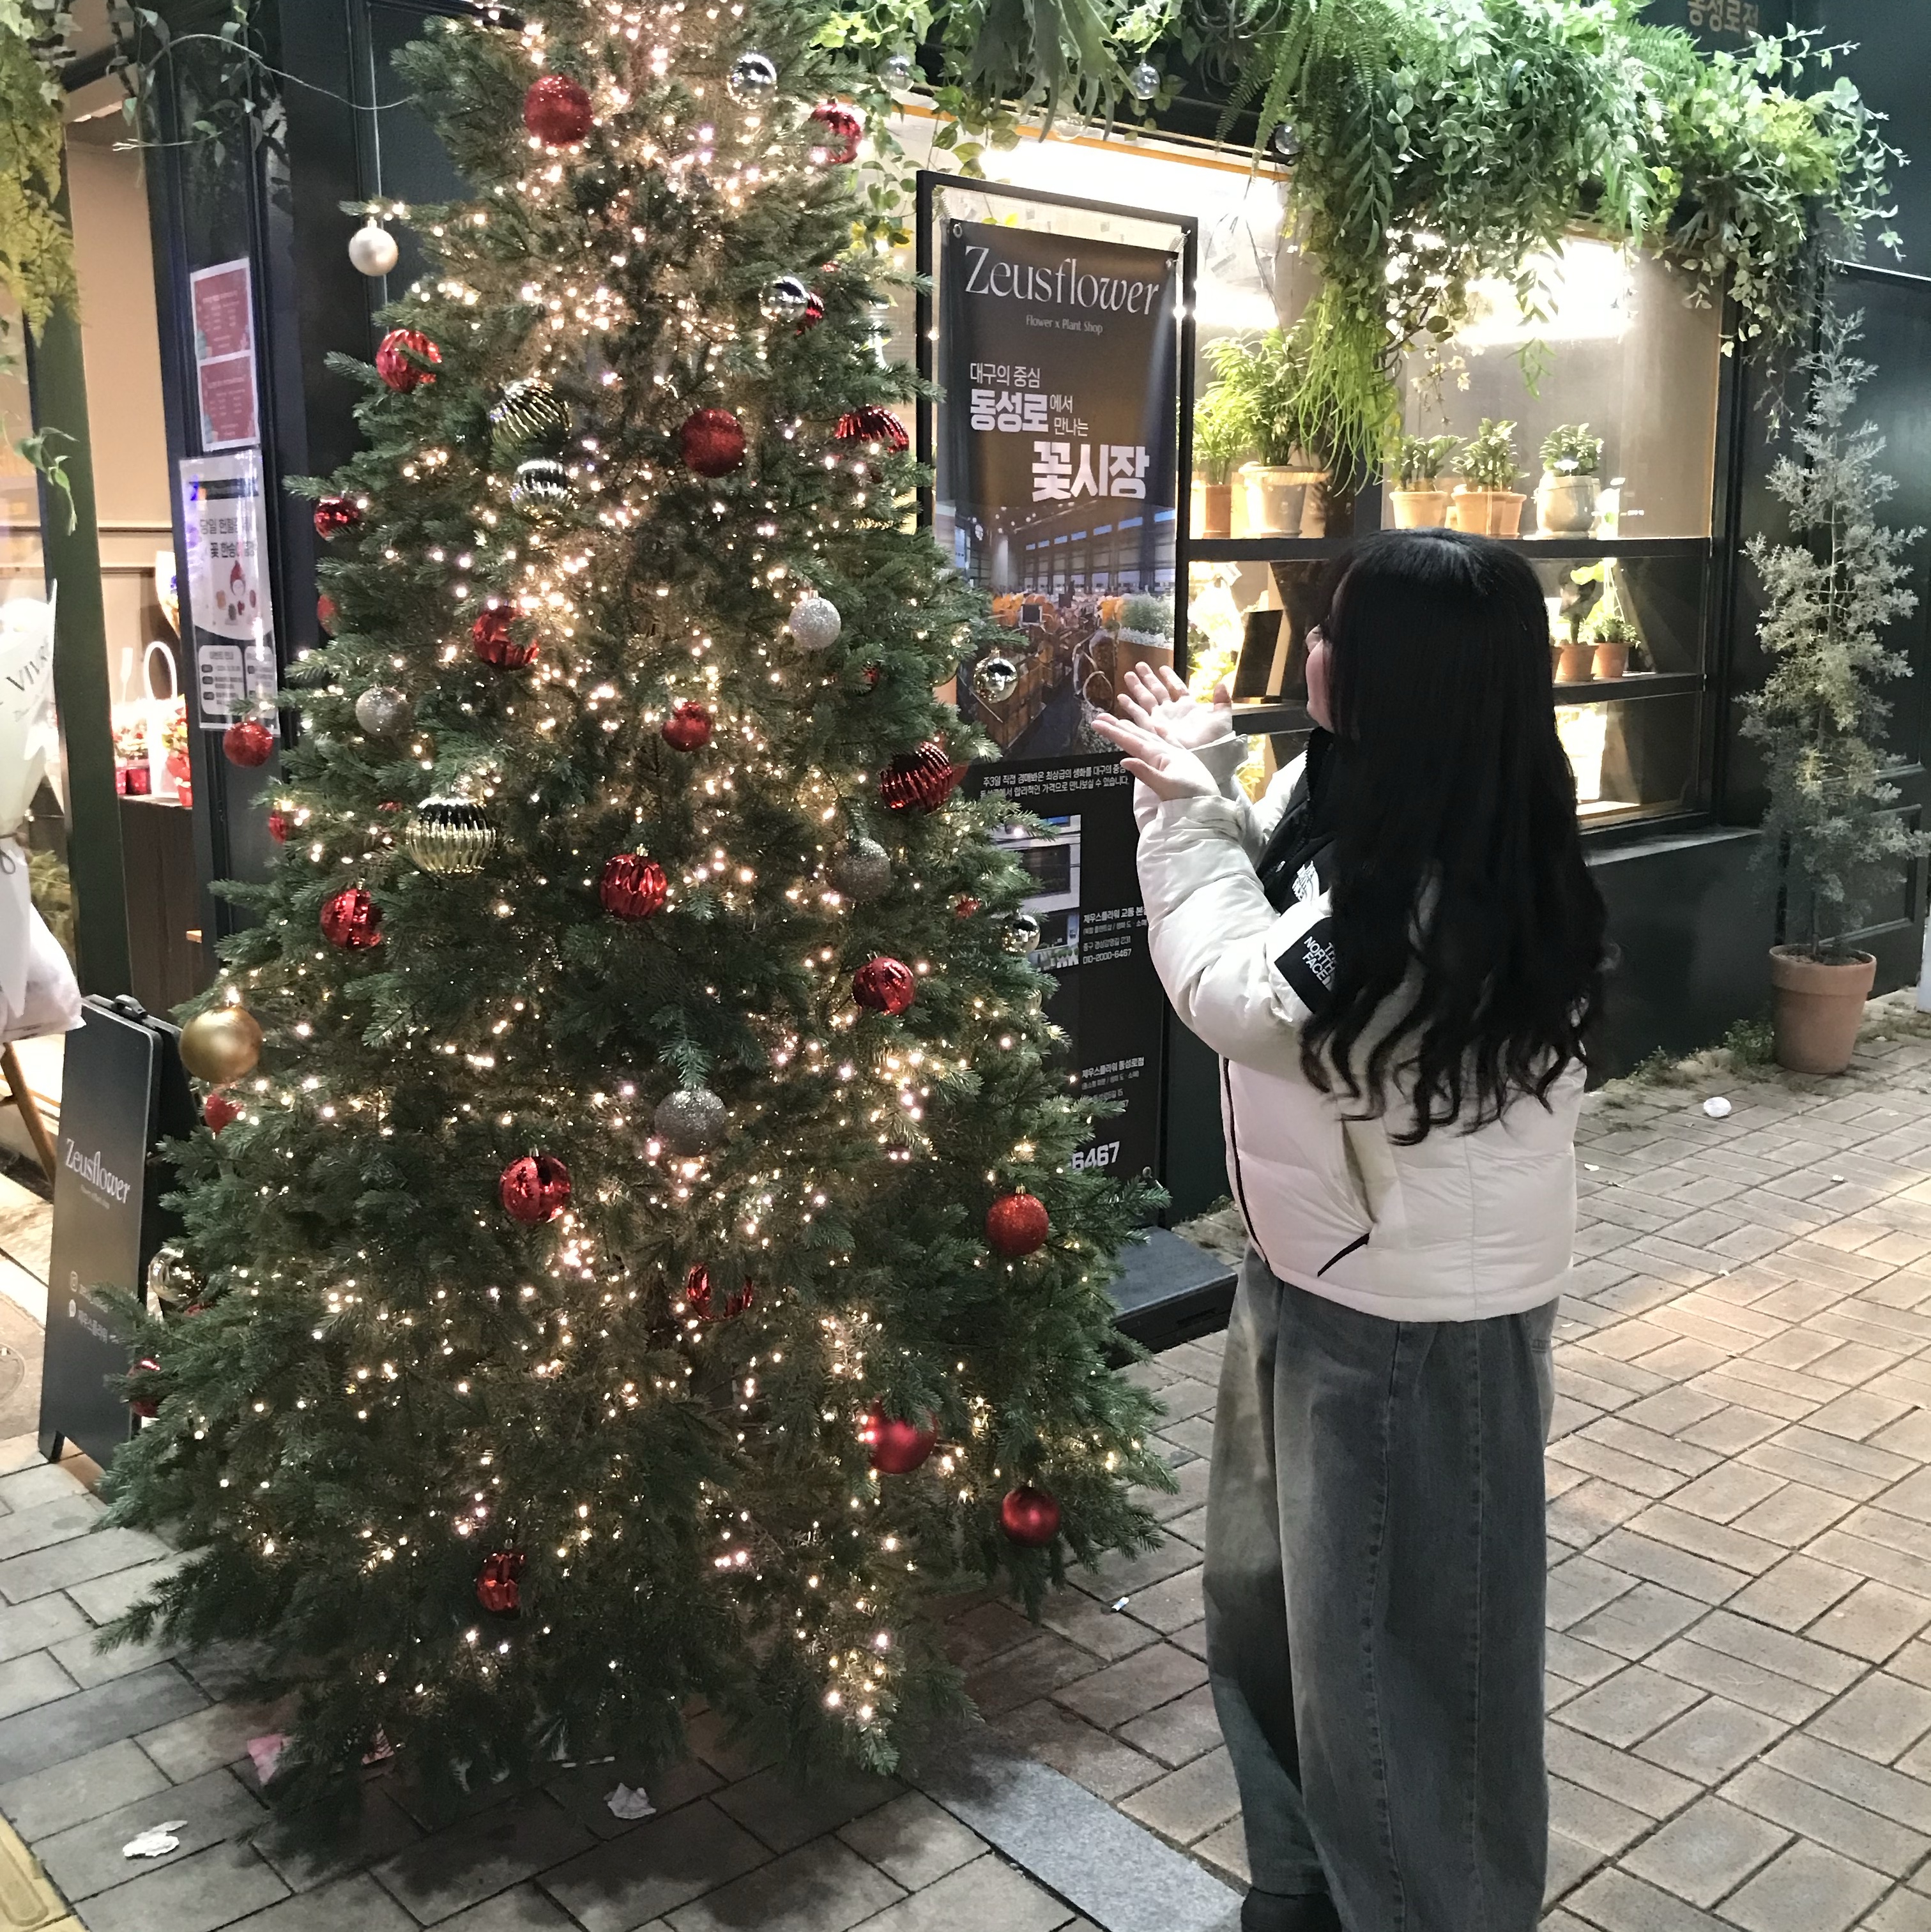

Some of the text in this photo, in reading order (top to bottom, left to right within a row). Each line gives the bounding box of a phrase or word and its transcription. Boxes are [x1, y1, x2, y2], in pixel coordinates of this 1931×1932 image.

[965, 245, 1159, 315] Zeusflower
[1026, 314, 1053, 328] Flower
[1062, 319, 1081, 331] Plant
[1084, 321, 1103, 335] Shop
[970, 363, 1041, 388] 대구의 중심
[1054, 417, 1088, 436] 만나는
[1032, 441, 1150, 502] 꽃시장
[983, 775, 1001, 787] 주3일
[1003, 774, 1016, 785] 직접
[1046, 768, 1072, 780] 최상급의
[1093, 764, 1112, 775] 대구의
[1014, 784, 1041, 797] 합리적인
[1042, 781, 1068, 793] 가격으로
[1069, 779, 1094, 791] 만나보실
[1095, 779, 1102, 787] 수
[1083, 948, 1132, 964] 010-2000-6467
[1302, 952, 1329, 981] FACE
[1304, 936, 1335, 974] NORTH
[66, 1137, 130, 1204] Zeusflower
